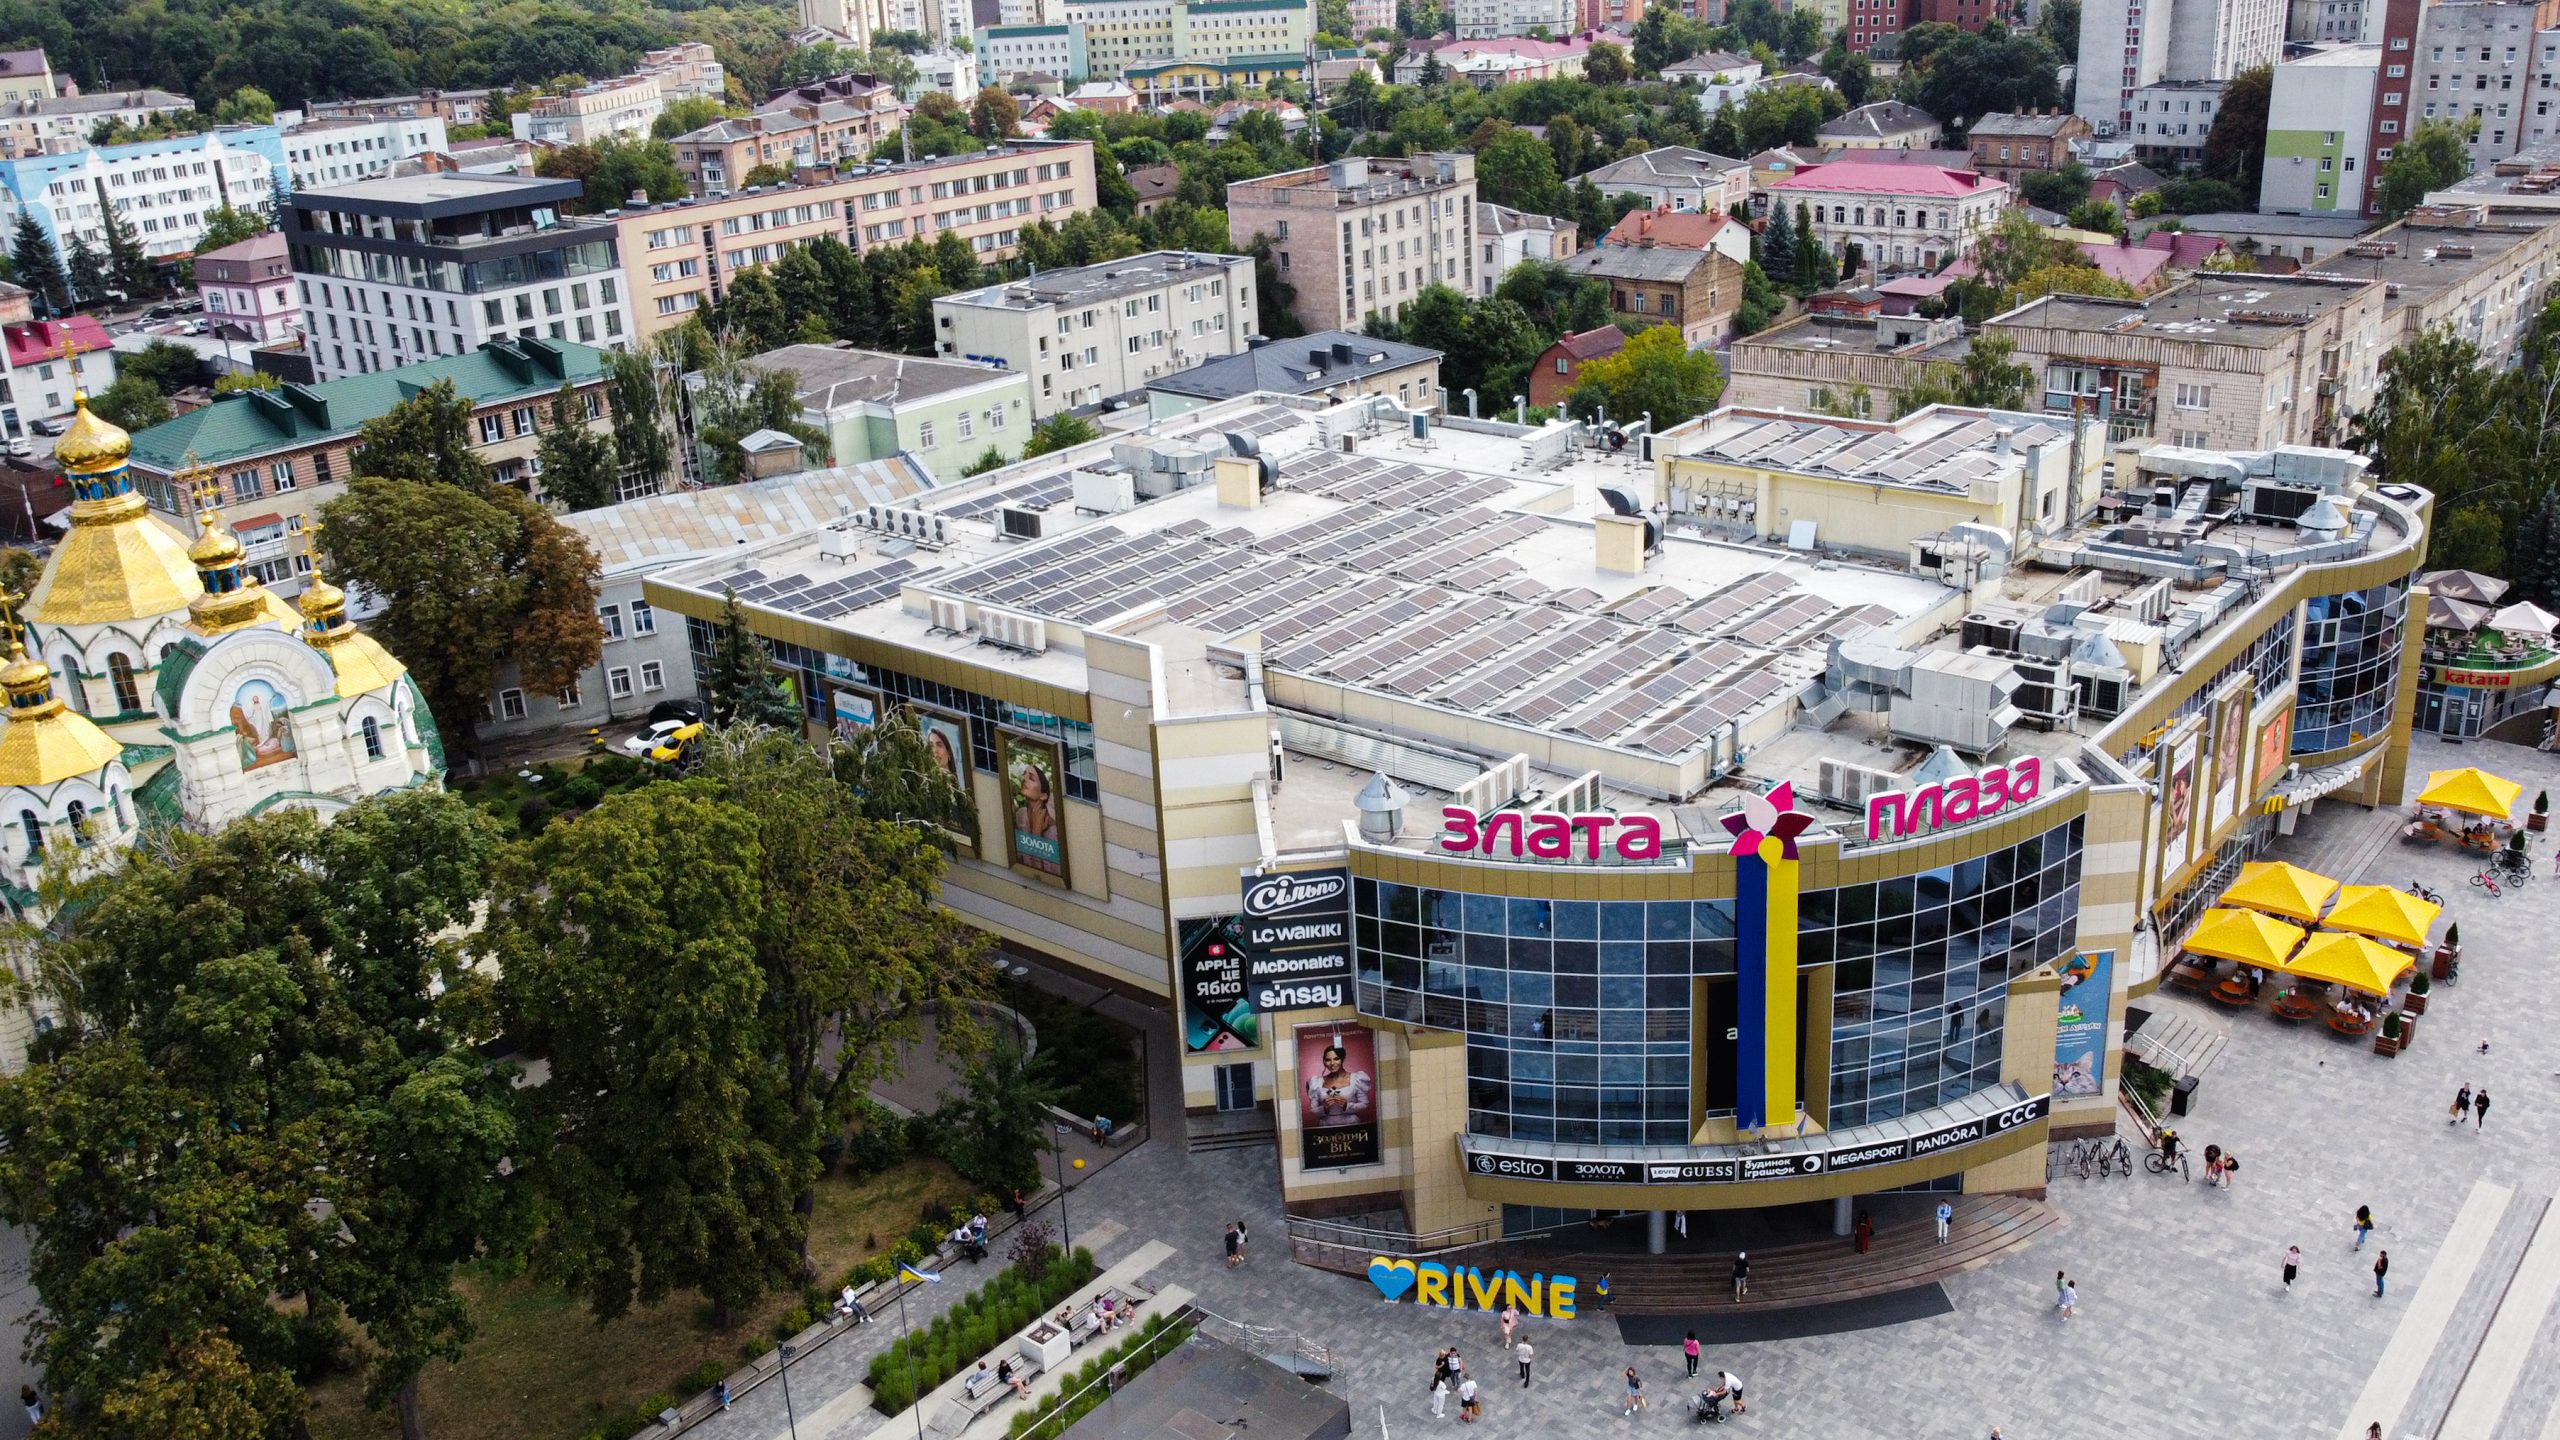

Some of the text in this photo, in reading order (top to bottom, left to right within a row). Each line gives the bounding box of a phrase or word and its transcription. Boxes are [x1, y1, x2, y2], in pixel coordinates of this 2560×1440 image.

[2444, 671, 2511, 686] katana
[1254, 879, 1339, 909] Сільпо
[1252, 928, 1274, 943] LC
[1196, 958, 1240, 971] APPLE
[1252, 955, 1344, 975] McDonald's
[1221, 969, 1240, 981] ЦЕ
[1260, 984, 1342, 1007] sinsay
[1998, 1103, 2037, 1129] CCC
[1831, 1145, 1904, 1166] MEGASPORT
[1499, 1160, 1544, 1175] estro
[1575, 1164, 1626, 1175] ЗОЛОТА
[1682, 1166, 1734, 1177] GUESS
[1744, 1159, 1791, 1170] будинок
[1417, 1261, 1577, 1320] RIVNE
